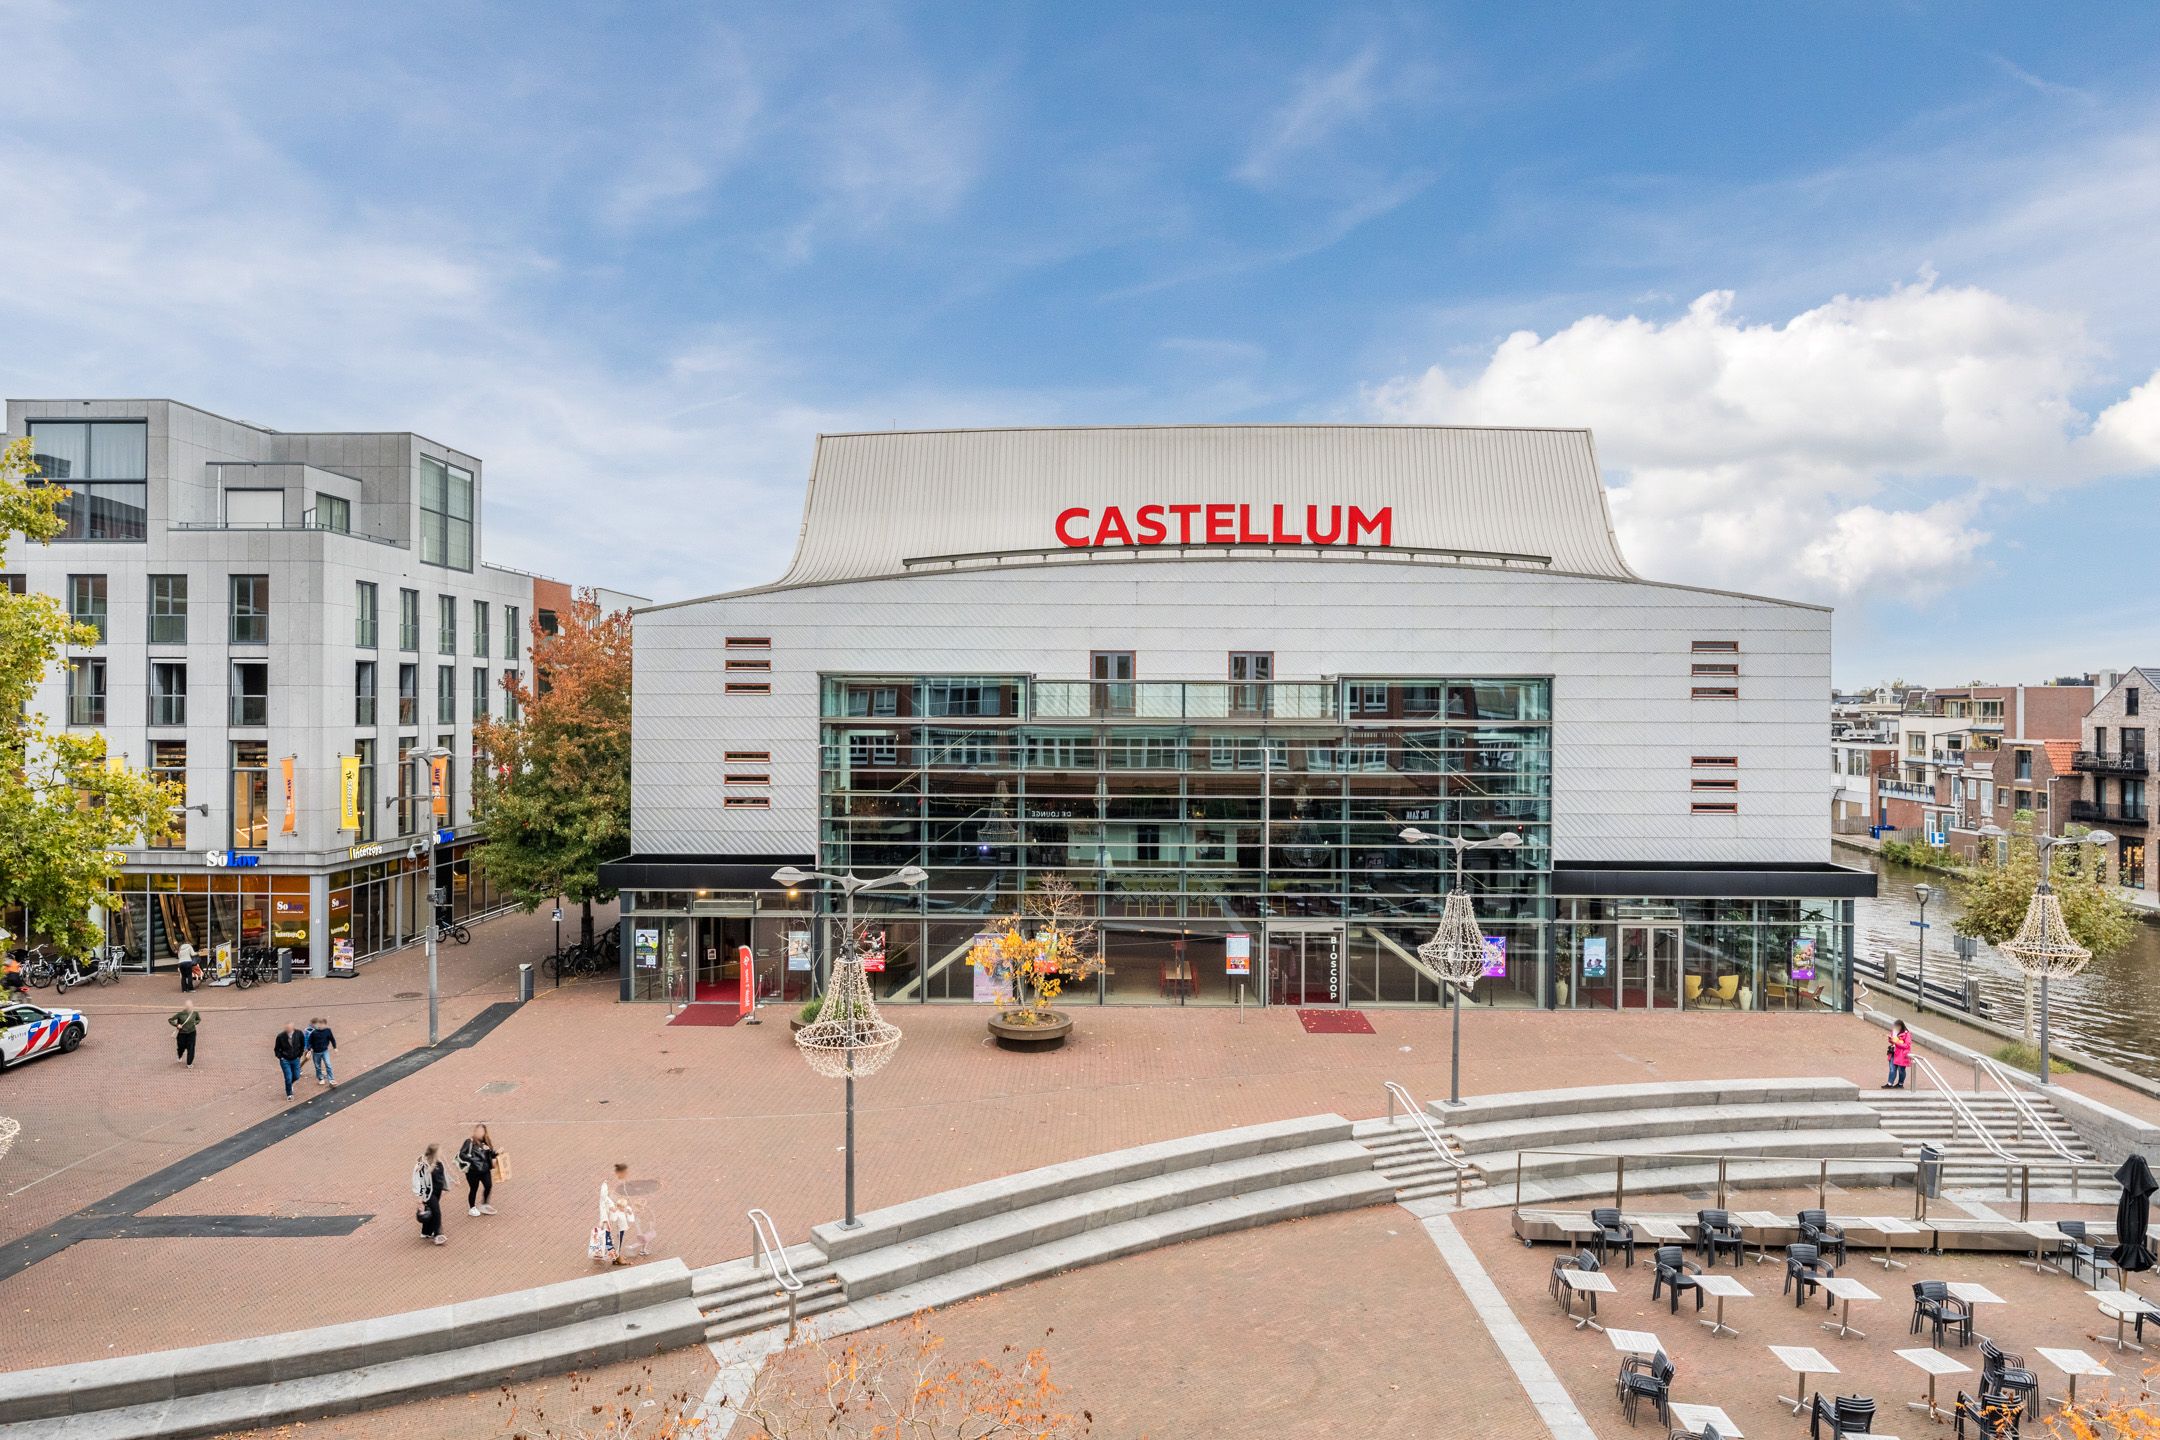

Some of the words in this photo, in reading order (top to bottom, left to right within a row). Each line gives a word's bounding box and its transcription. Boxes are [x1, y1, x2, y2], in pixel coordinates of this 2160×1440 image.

[1055, 503, 1392, 547] CASTELLUM
[667, 928, 675, 983] THEATER
[1329, 936, 1338, 1000] BIOSCOOP
